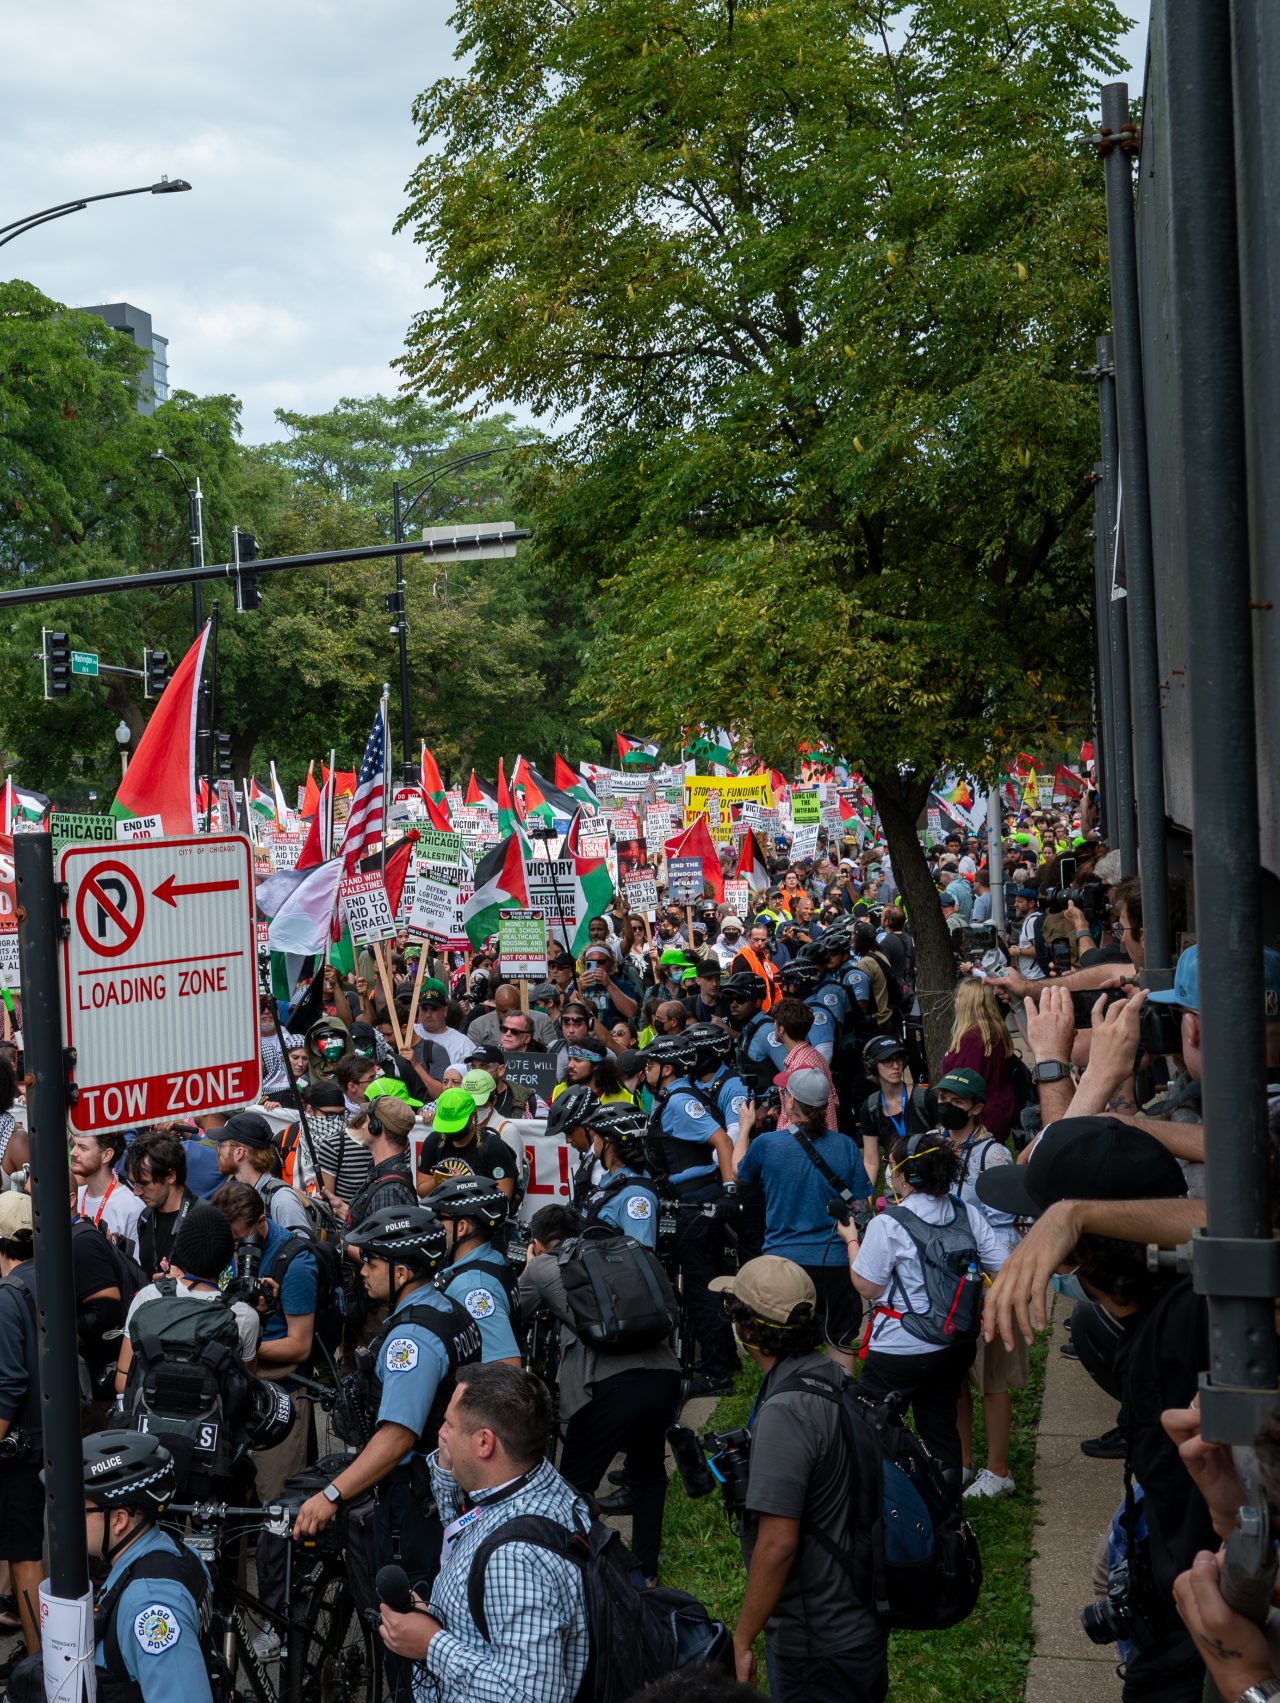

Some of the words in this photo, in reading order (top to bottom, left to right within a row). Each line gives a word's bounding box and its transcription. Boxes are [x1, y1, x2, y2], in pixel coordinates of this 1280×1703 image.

[727, 786, 759, 797] FUNDING
[51, 815, 70, 823] FROM
[123, 821, 142, 832] END
[144, 818, 156, 828] US
[453, 820, 480, 829] VICTORY
[51, 823, 113, 840] CHICAGO
[419, 836, 459, 849] CHICAGO
[178, 848, 193, 856] CITY
[417, 850, 458, 863] PALESTINE
[526, 862, 573, 877] VICTORY
[340, 876, 363, 888] STAND
[364, 872, 382, 882] WITH
[541, 876, 548, 884] TO
[626, 874, 654, 882] PALESTINE!
[341, 880, 384, 897] PALESTINE!
[426, 884, 448, 896] DEFEND
[629, 890, 643, 898] AID
[346, 896, 366, 909] END
[369, 892, 385, 904] U.S
[416, 897, 452, 912] REPRODUCTIVE
[630, 895, 657, 905] ISRAEL!
[349, 907, 369, 921] AID
[374, 902, 388, 916] TO
[419, 905, 445, 919] RIGHTS!
[352, 914, 392, 933] ISRAEL!
[78, 975, 166, 1011] LOADING
[178, 967, 228, 997] ZONE
[659, 1040, 674, 1048] POLICE
[534, 1061, 555, 1071] WILL
[520, 1074, 538, 1085] FOR
[82, 1082, 148, 1125] TOW
[166, 1067, 244, 1111] ZONE
[567, 1095, 577, 1110] POLICE
[456, 1182, 478, 1191] POLICE
[629, 1197, 650, 1209] CHICAGO
[630, 1210, 649, 1220] POLICE
[385, 1220, 411, 1233] POLICE
[468, 1291, 491, 1306] CHICAGO
[472, 1304, 493, 1317] POLICE
[389, 1341, 416, 1355] CHICAGO
[452, 1323, 481, 1362] POLICE
[388, 1360, 412, 1369] POLICE
[277, 1391, 290, 1423] PRESS
[90, 1456, 123, 1476] POLICE
[458, 1511, 476, 1527] DNC
[138, 1609, 170, 1637] CHICAGO
[52, 1639, 77, 1648] WEEKDAYS
[147, 1626, 176, 1650] POLICE
